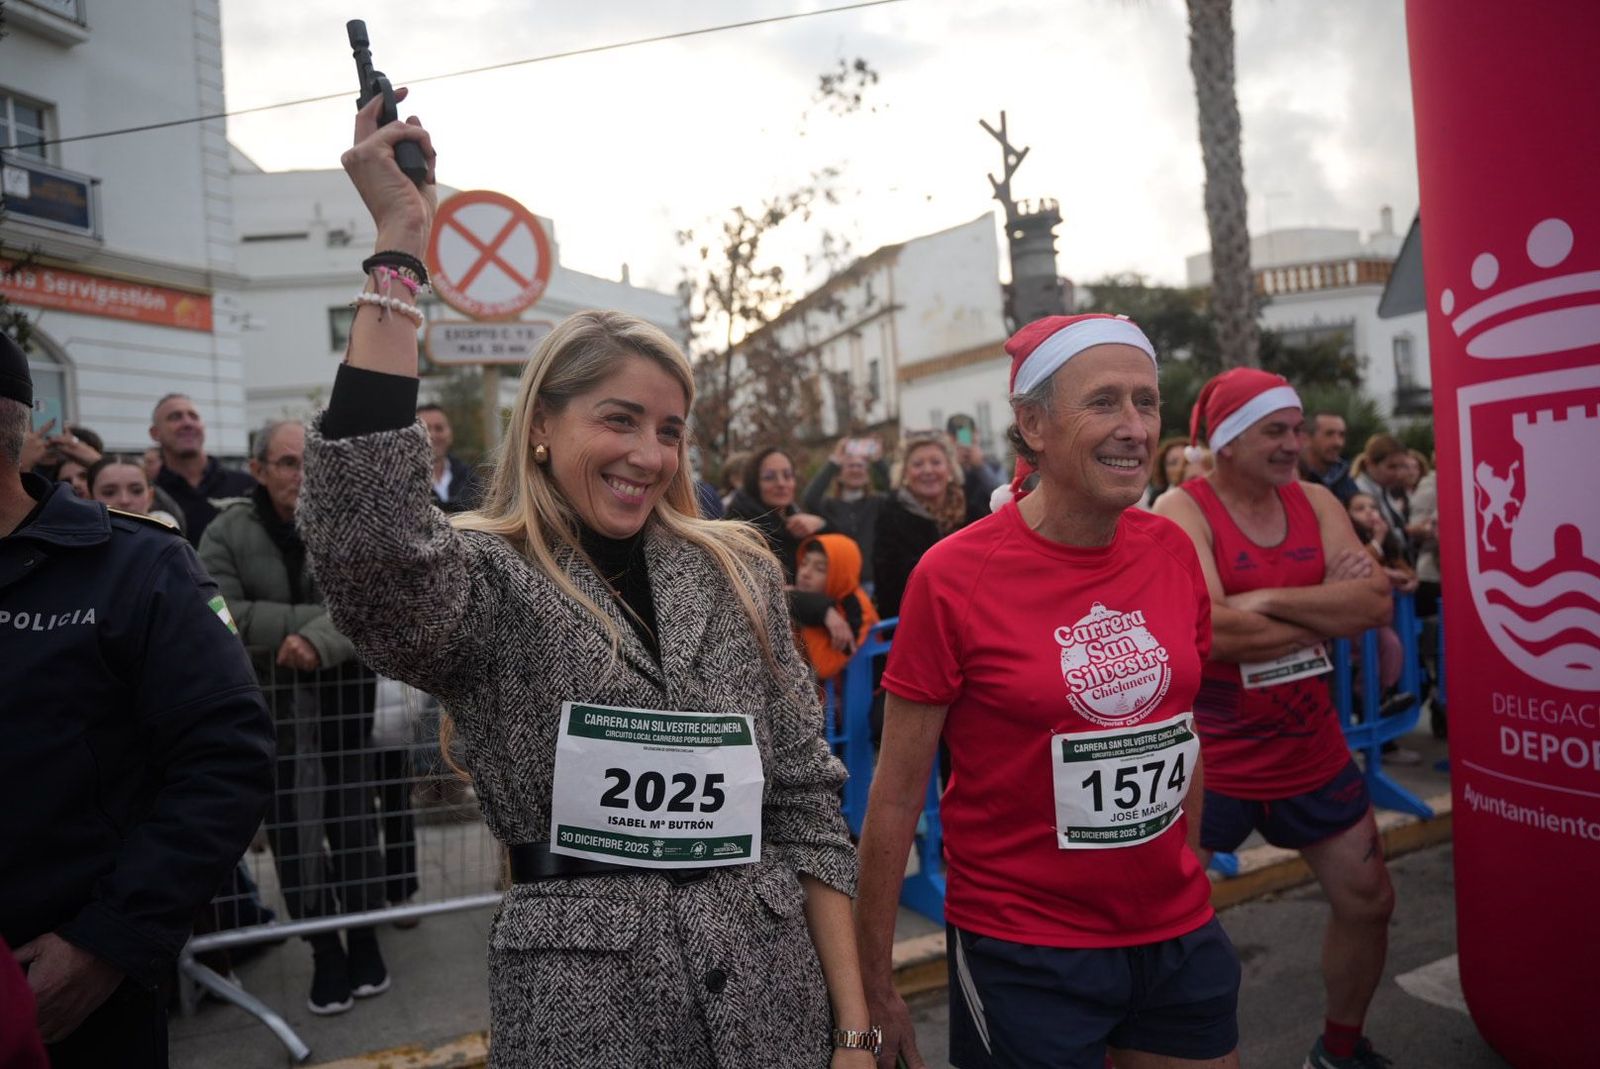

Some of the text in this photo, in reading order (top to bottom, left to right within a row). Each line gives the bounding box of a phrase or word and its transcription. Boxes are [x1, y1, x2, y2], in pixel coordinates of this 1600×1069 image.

[0, 608, 96, 631] POLICIA
[1054, 610, 1146, 648] Carrera
[1087, 637, 1137, 664] San
[1066, 646, 1169, 693] Silvestre
[1092, 673, 1156, 700] Chiclanera
[584, 713, 629, 729] CARRERA
[630, 718, 650, 731] SAN
[651, 721, 700, 733] SILVESTRE
[605, 730, 633, 739] CIRCUITO
[633, 732, 652, 740] LOCAL
[652, 734, 684, 743] CARRERAS
[684, 736, 713, 744] POPULARES
[1074, 740, 1108, 753] CARRERA
[1108, 739, 1122, 749] SAN
[1122, 734, 1158, 747] SILVESTRE
[600, 767, 726, 814] 2025
[1082, 752, 1186, 812] 1574
[608, 816, 714, 830] ISABEL Mª BUTRÓN
[1464, 783, 1600, 841] Ayuntamiento
[560, 831, 574, 842] 30
[575, 833, 623, 851] DICIEMBRE
[624, 841, 650, 853] 2025
[1070, 827, 1137, 839] 30 DICIEMBRE 2025
